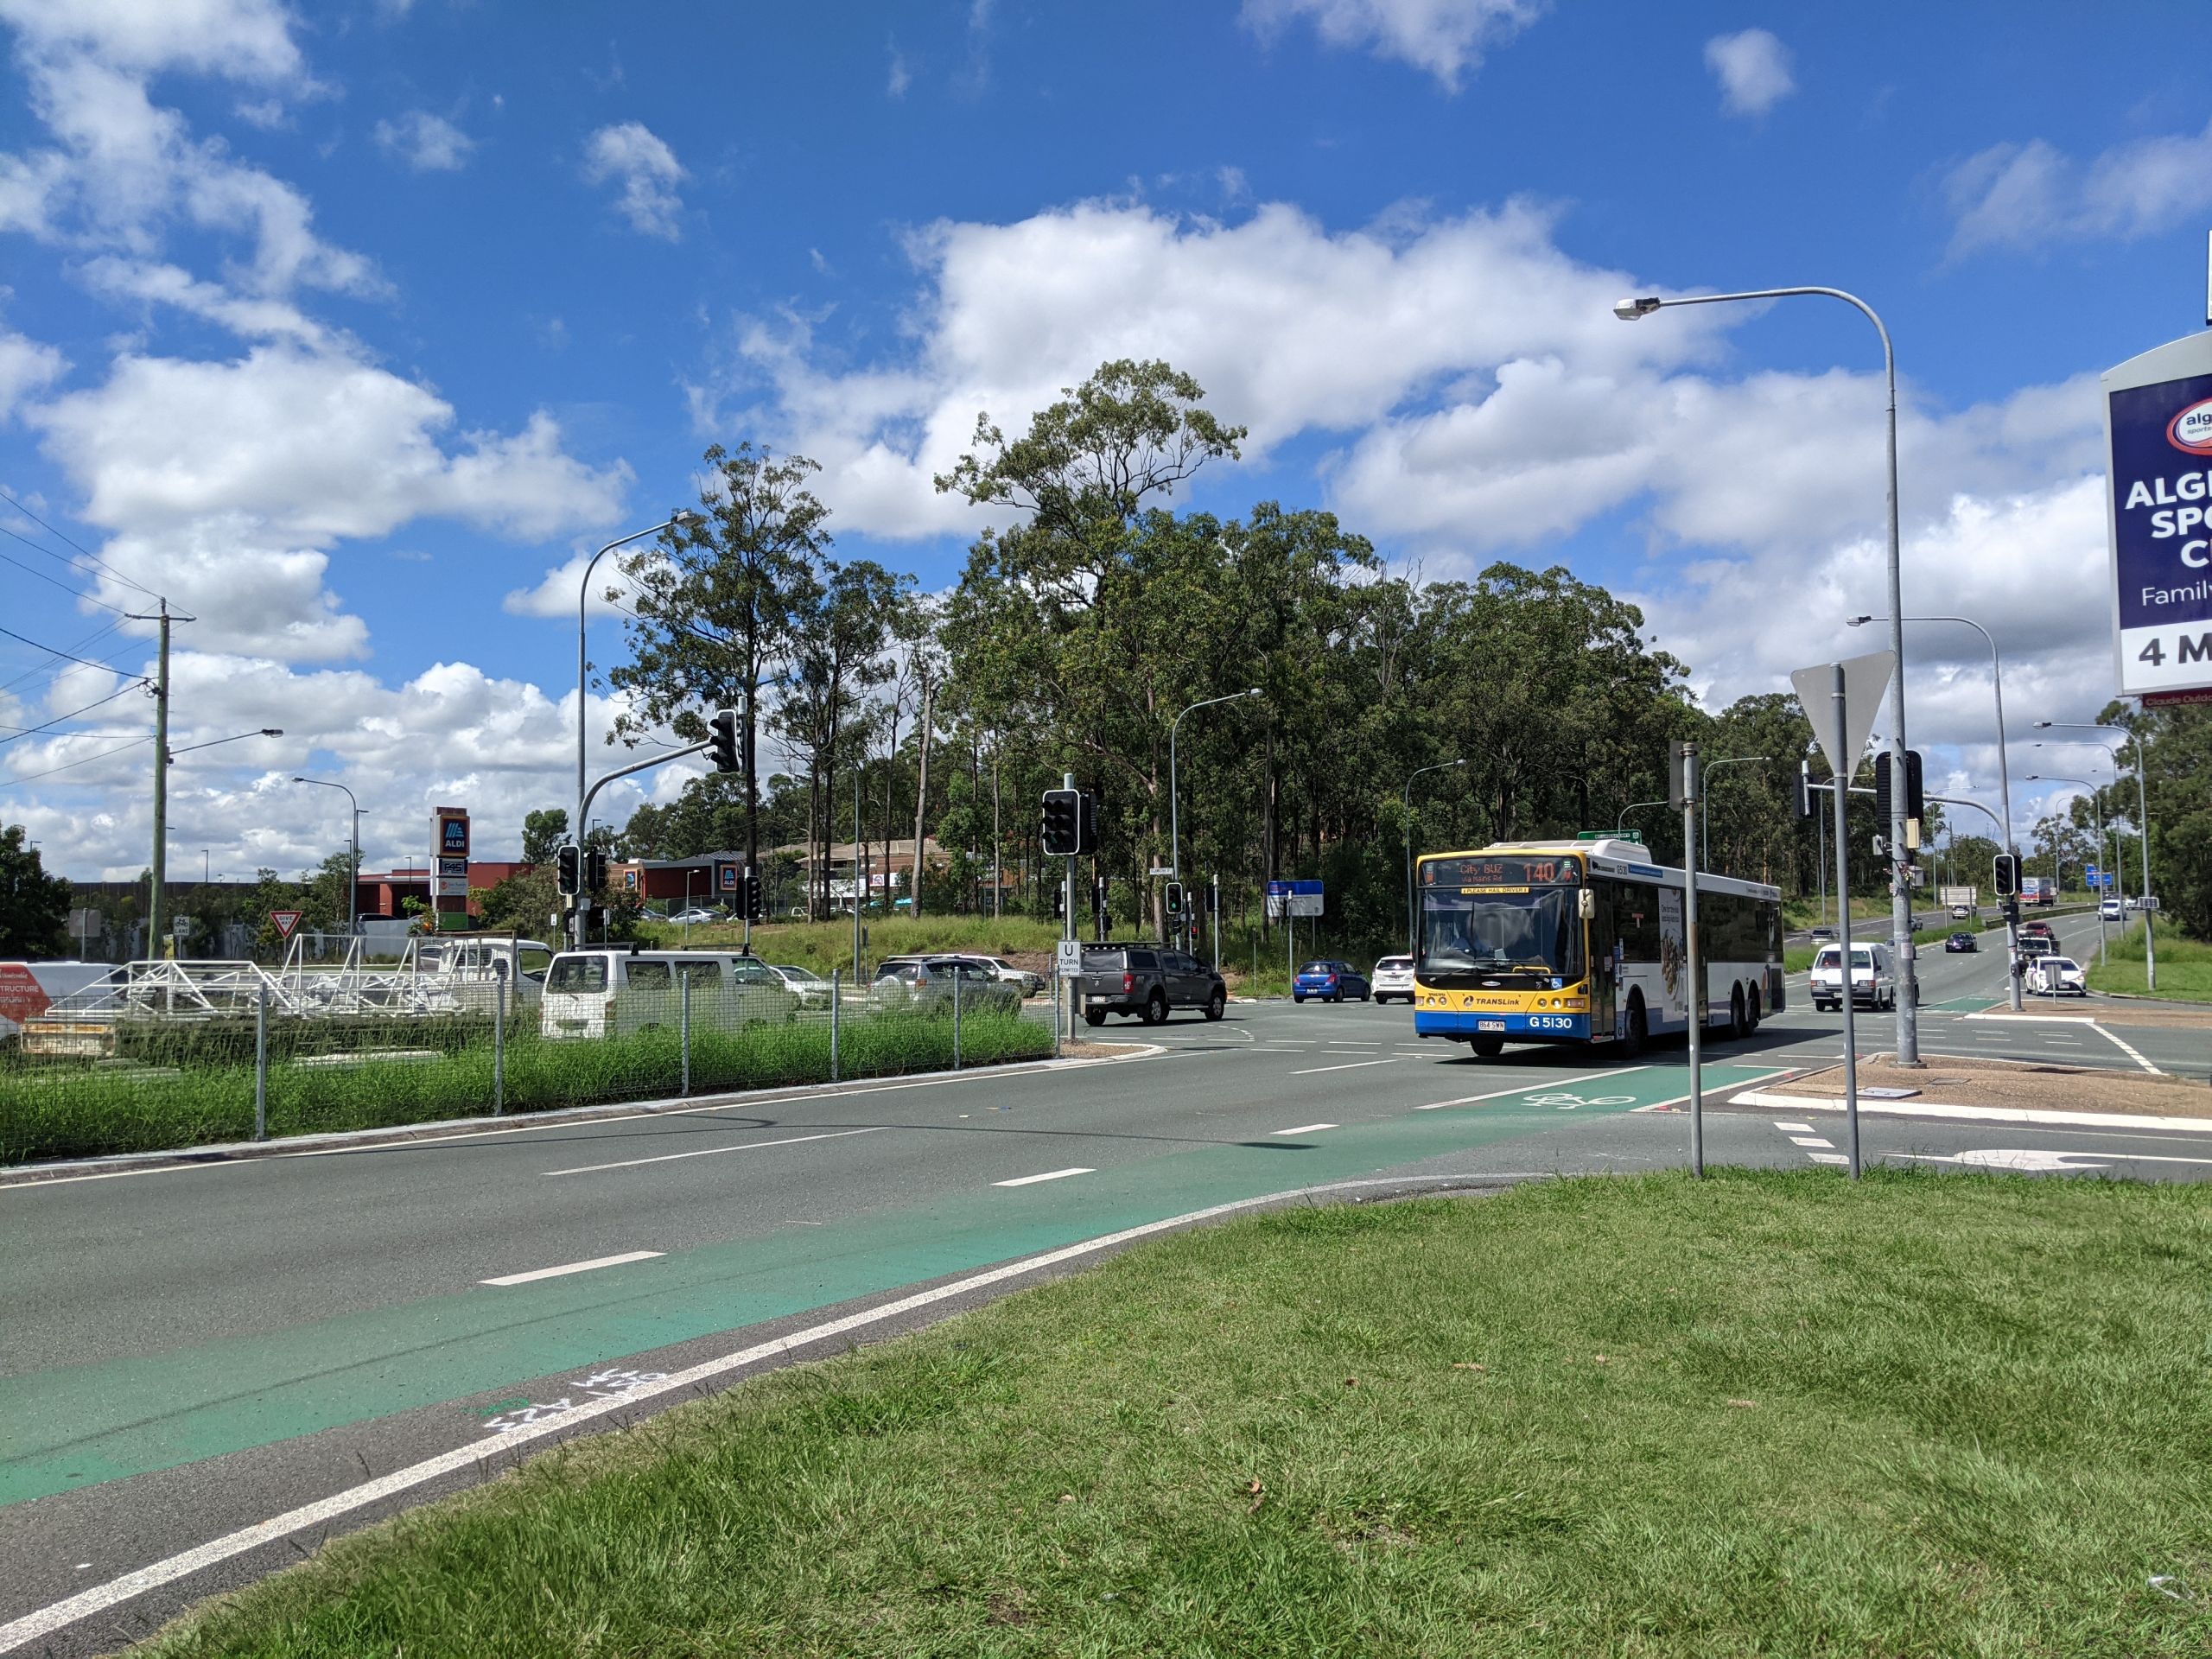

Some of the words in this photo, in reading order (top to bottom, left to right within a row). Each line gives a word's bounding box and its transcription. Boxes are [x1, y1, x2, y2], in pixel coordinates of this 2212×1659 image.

[2186, 413, 2212, 425] alg
[2125, 470, 2212, 510] ALG
[2151, 506, 2212, 538] SP
[2181, 539, 2212, 568] C
[2142, 580, 2212, 606] Famil
[2139, 638, 2166, 666] 4
[443, 861, 464, 873] F45
[1459, 864, 1478, 875] City
[1484, 864, 1503, 874] BUZ
[1523, 862, 1554, 882] 140
[1065, 944, 1073, 956] U
[1529, 1017, 1540, 1027] G
[1542, 1017, 1573, 1028] 5130
